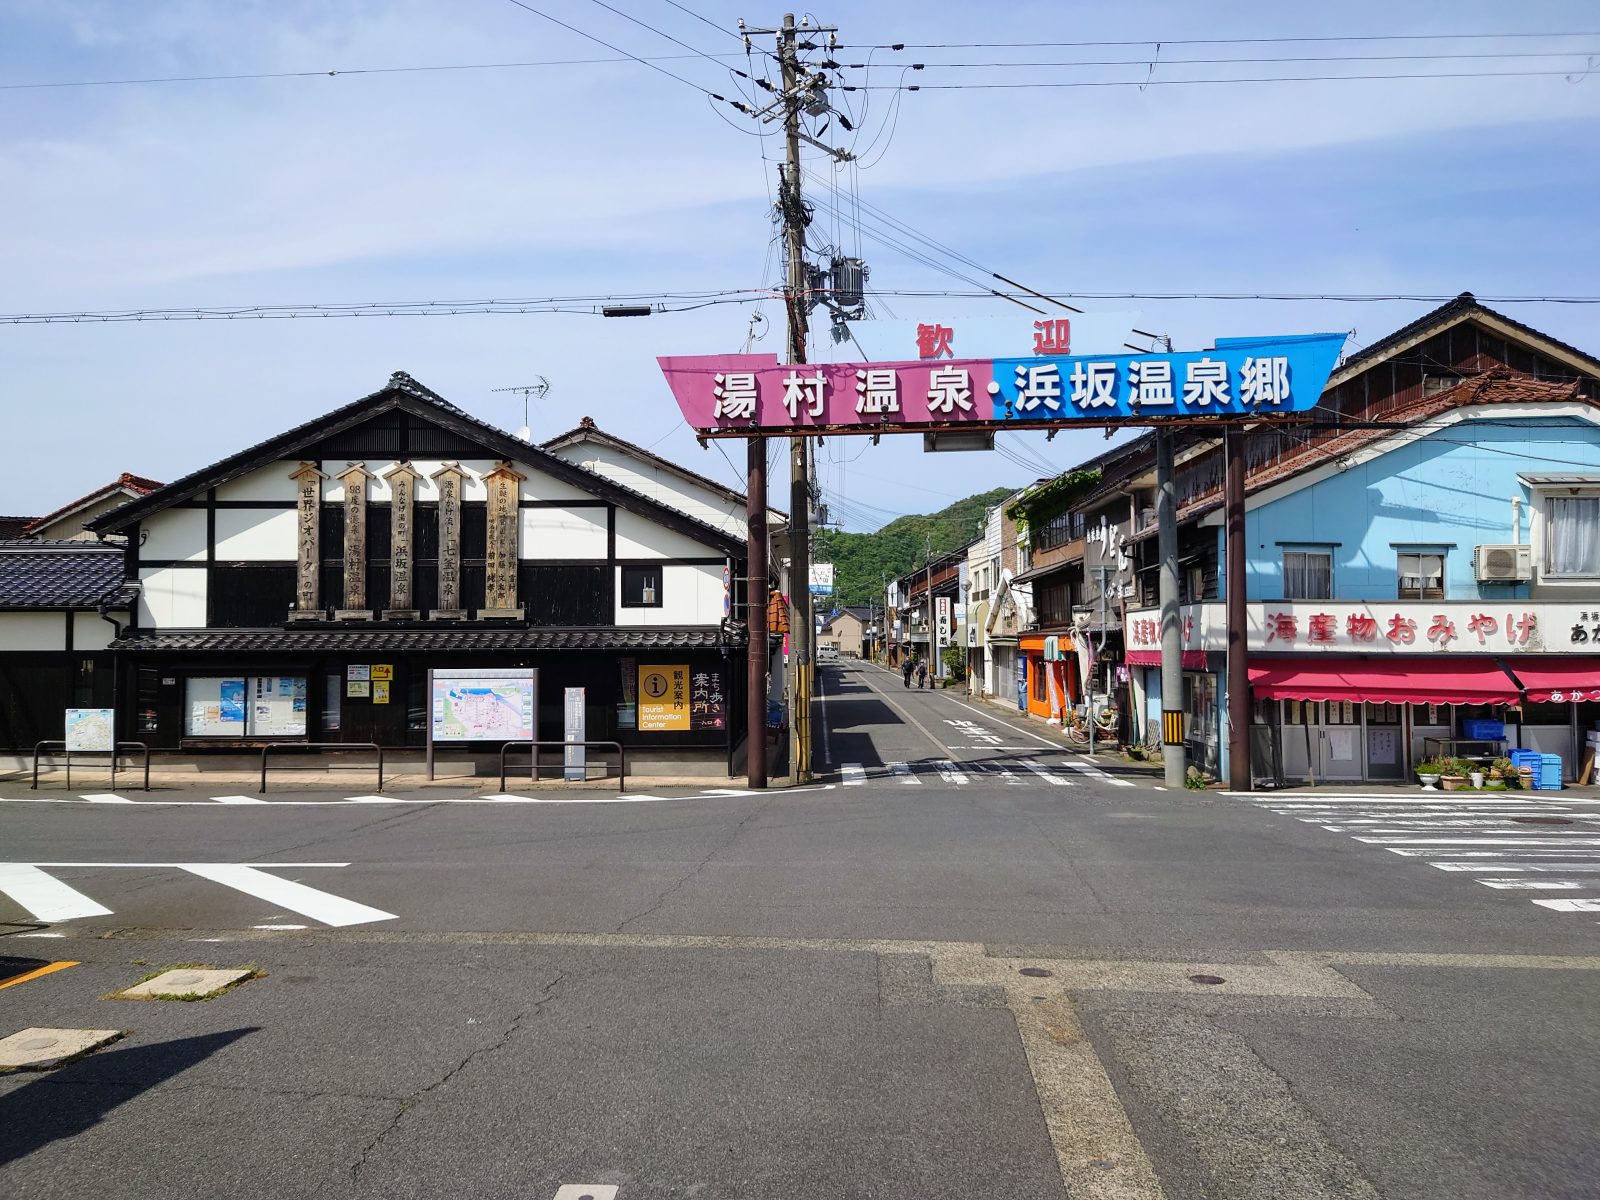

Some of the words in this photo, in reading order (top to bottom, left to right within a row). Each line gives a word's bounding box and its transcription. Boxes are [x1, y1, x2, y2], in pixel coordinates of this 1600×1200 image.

[916, 319, 1071, 360] 歓迎
[1266, 612, 1536, 645] 海産物おみやげ
[673, 670, 683, 710] 観光案内
[692, 672, 710, 714] 案内所
[710, 672, 723, 713] まち歩き
